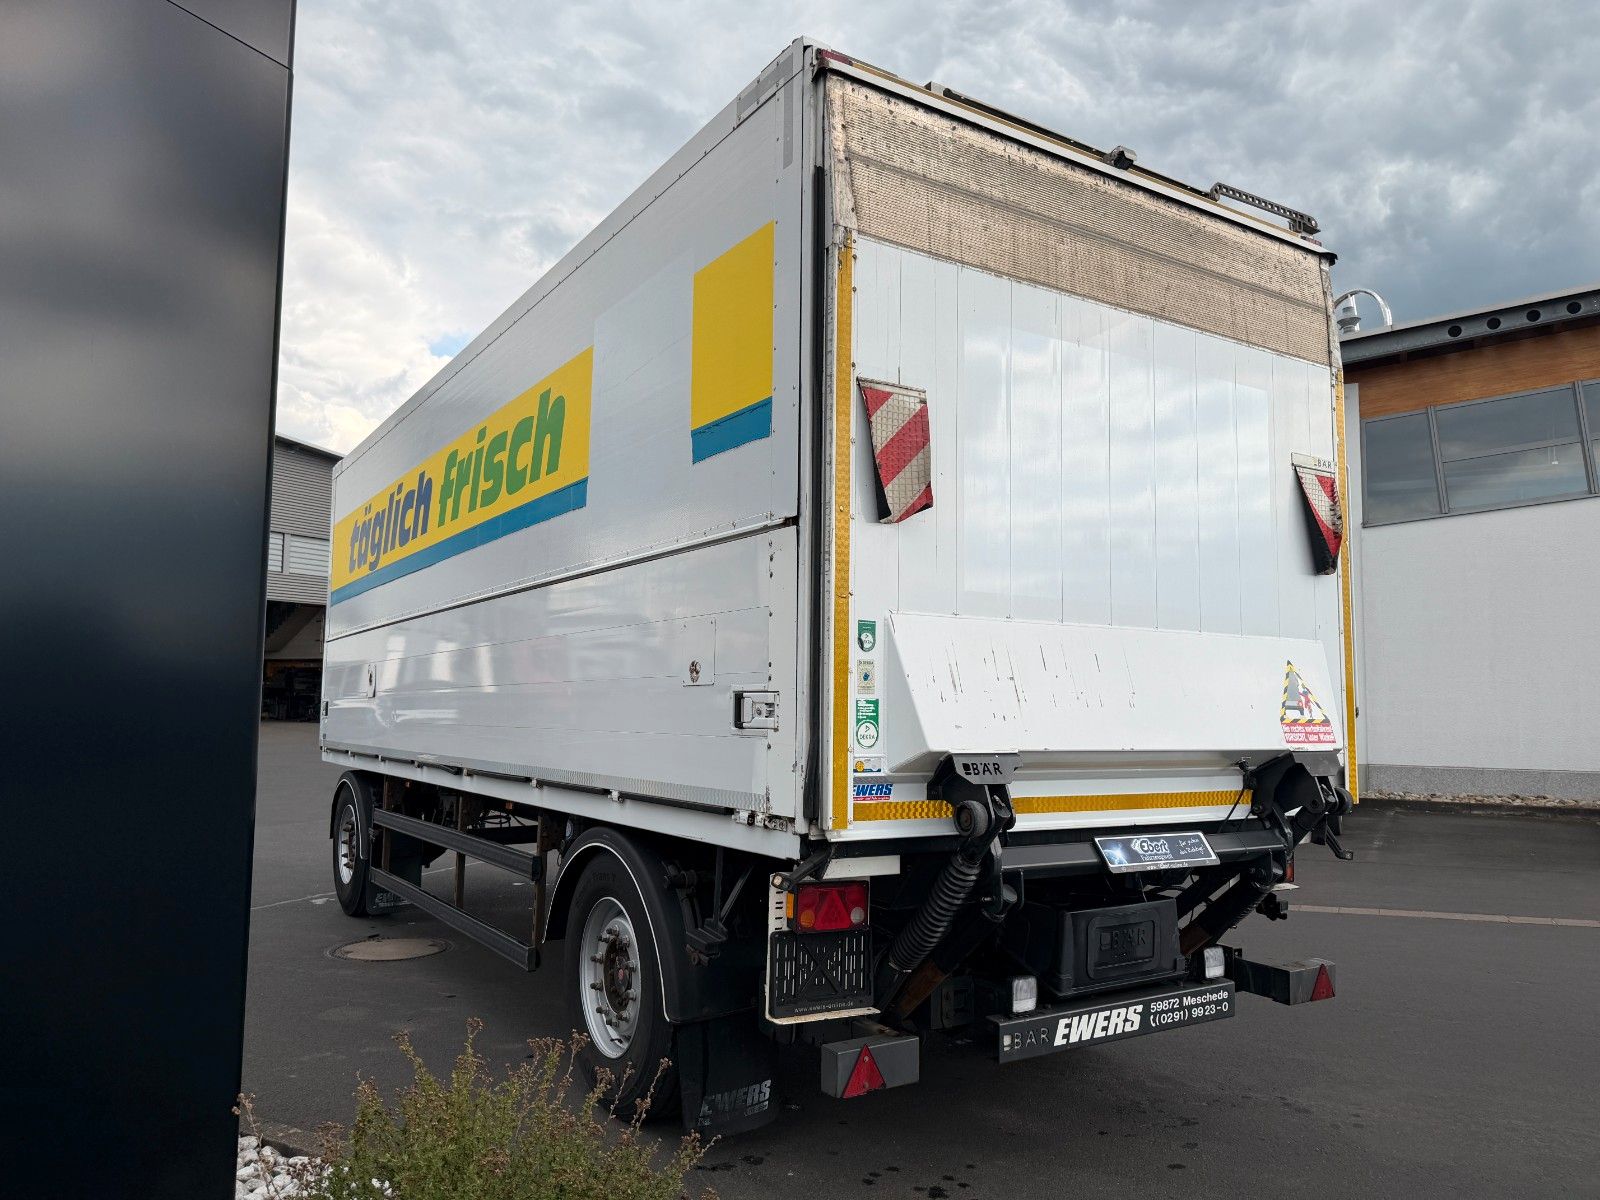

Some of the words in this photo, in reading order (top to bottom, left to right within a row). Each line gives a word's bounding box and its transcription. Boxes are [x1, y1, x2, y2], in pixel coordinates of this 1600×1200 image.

[349, 471, 433, 572] täglich
[438, 388, 566, 528] frisch
[971, 762, 1003, 775] BÄR
[1139, 839, 1169, 853] Ebert
[1150, 998, 1180, 1013] 59872
[1183, 990, 1229, 1007] Meschede
[1053, 1004, 1143, 1047] EWERS
[1156, 1009, 1188, 1026] (0291)
